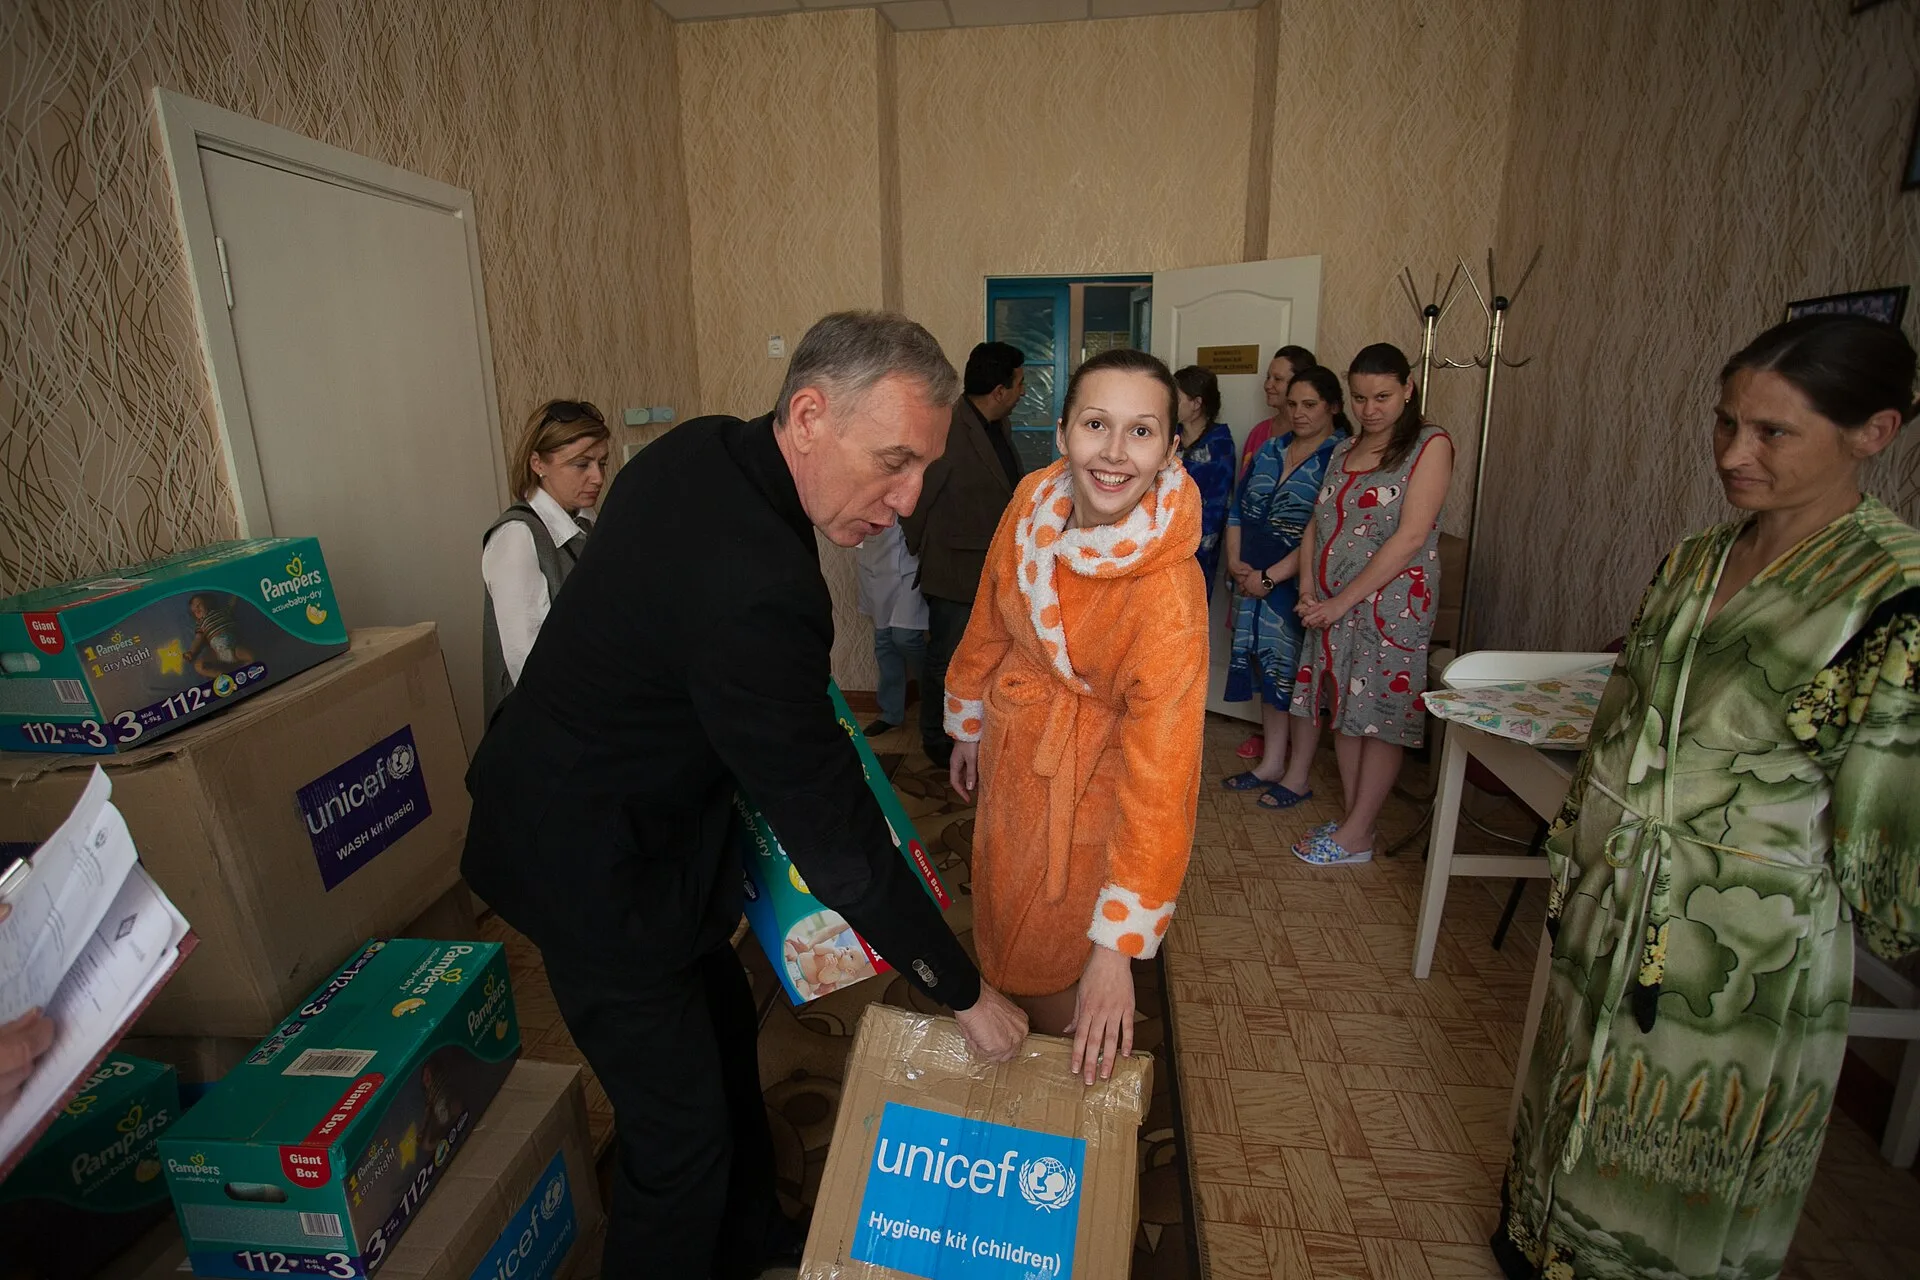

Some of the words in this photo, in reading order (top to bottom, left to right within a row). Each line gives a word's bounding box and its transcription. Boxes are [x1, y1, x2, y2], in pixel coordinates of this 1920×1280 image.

[260, 570, 322, 602] Pampers
[32, 621, 56, 631] Giant
[39, 634, 58, 644] Box
[84, 646, 97, 661] 1
[96, 638, 133, 657] Pampers
[91, 664, 104, 678] 1
[103, 660, 121, 673] dry
[121, 647, 151, 667] Night
[161, 687, 206, 720] 112
[22, 722, 62, 744] 112
[81, 719, 107, 748] 3
[113, 711, 143, 743] 3
[306, 757, 387, 834] unicef
[336, 831, 370, 861] WASH
[370, 822, 384, 838] kit
[384, 799, 415, 829] (basic)
[914, 849, 931, 878] Giant
[930, 878, 943, 899] Box
[328, 968, 359, 992] 112
[412, 945, 474, 995] Pampers
[300, 1002, 327, 1016] 3
[467, 979, 506, 1037] Pampers
[340, 1082, 373, 1111] Giant
[318, 1113, 347, 1135] Box
[72, 1109, 168, 1185] Pampers
[289, 1154, 322, 1165] Giant
[168, 1158, 220, 1176] Pampers
[296, 1168, 319, 1179] Box
[357, 1145, 384, 1181] Pampers
[360, 1178, 374, 1196] dry
[374, 1147, 396, 1180] Night
[877, 1137, 1018, 1198] unicef
[400, 1167, 429, 1216] 112
[365, 1228, 387, 1270] 3
[868, 1210, 941, 1244] Hygiene
[944, 1229, 968, 1251] kit
[971, 1235, 1061, 1277] (children)
[237, 1250, 290, 1274] 112
[325, 1252, 356, 1279] 3
